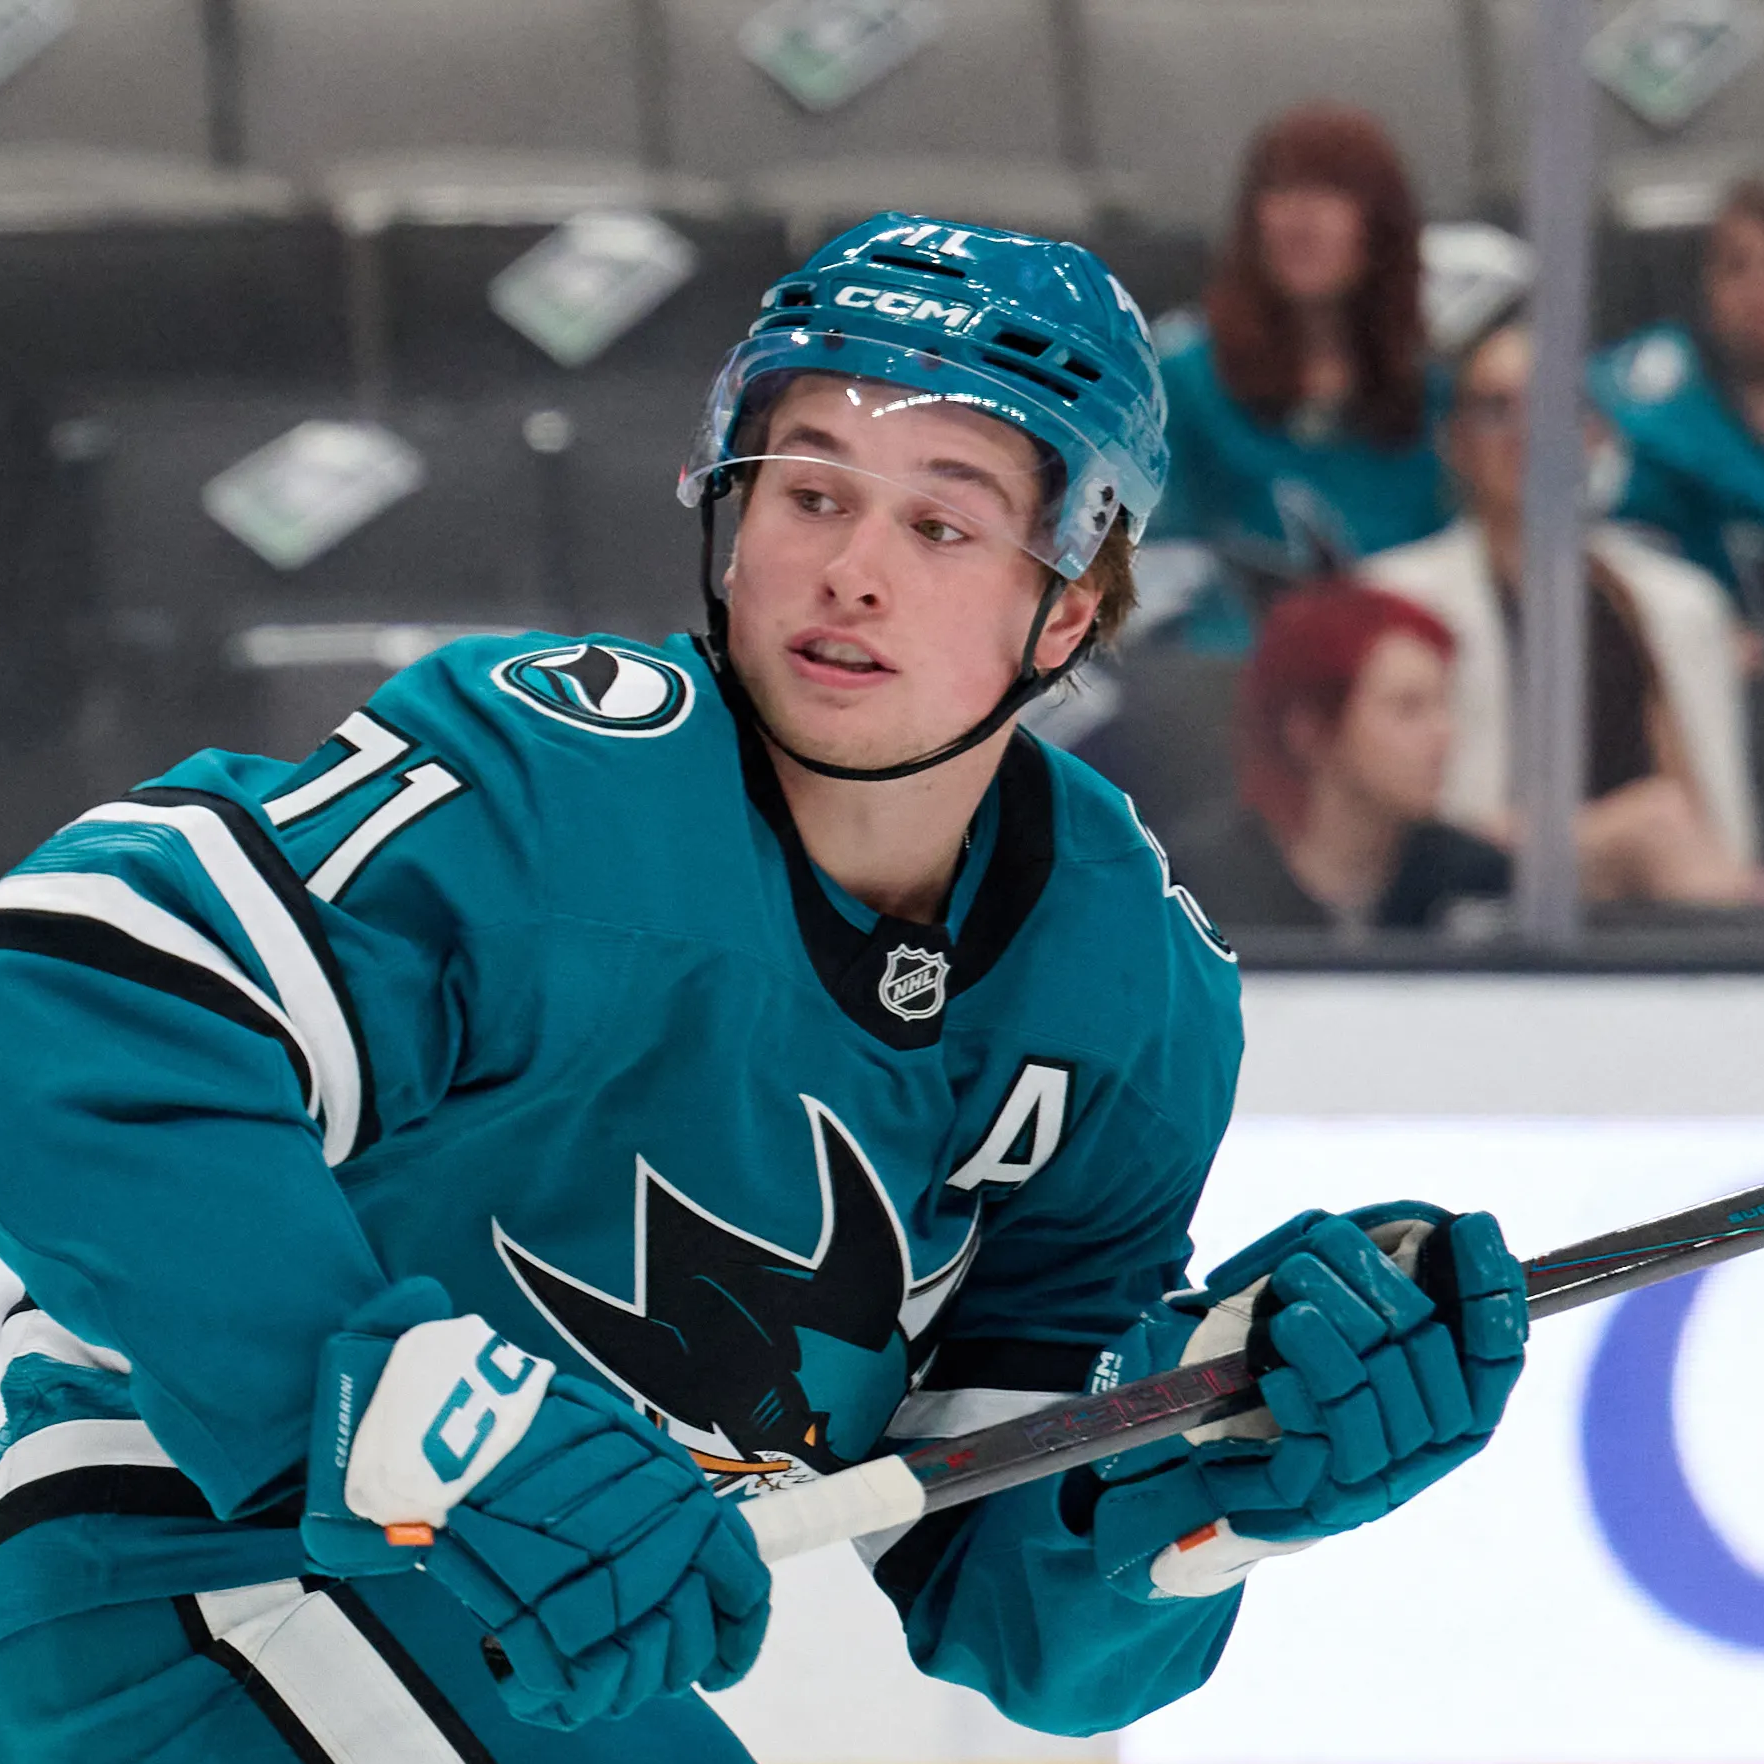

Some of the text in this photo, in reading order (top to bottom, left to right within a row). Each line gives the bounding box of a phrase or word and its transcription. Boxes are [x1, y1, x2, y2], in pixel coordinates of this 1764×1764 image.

[834, 285, 973, 328] CCM
[261, 710, 464, 903] 71
[893, 969, 935, 1001] NHL
[945, 1063, 1069, 1191] A
[334, 1372, 354, 1469] CELEBRINI
[421, 1333, 538, 1485] CC
